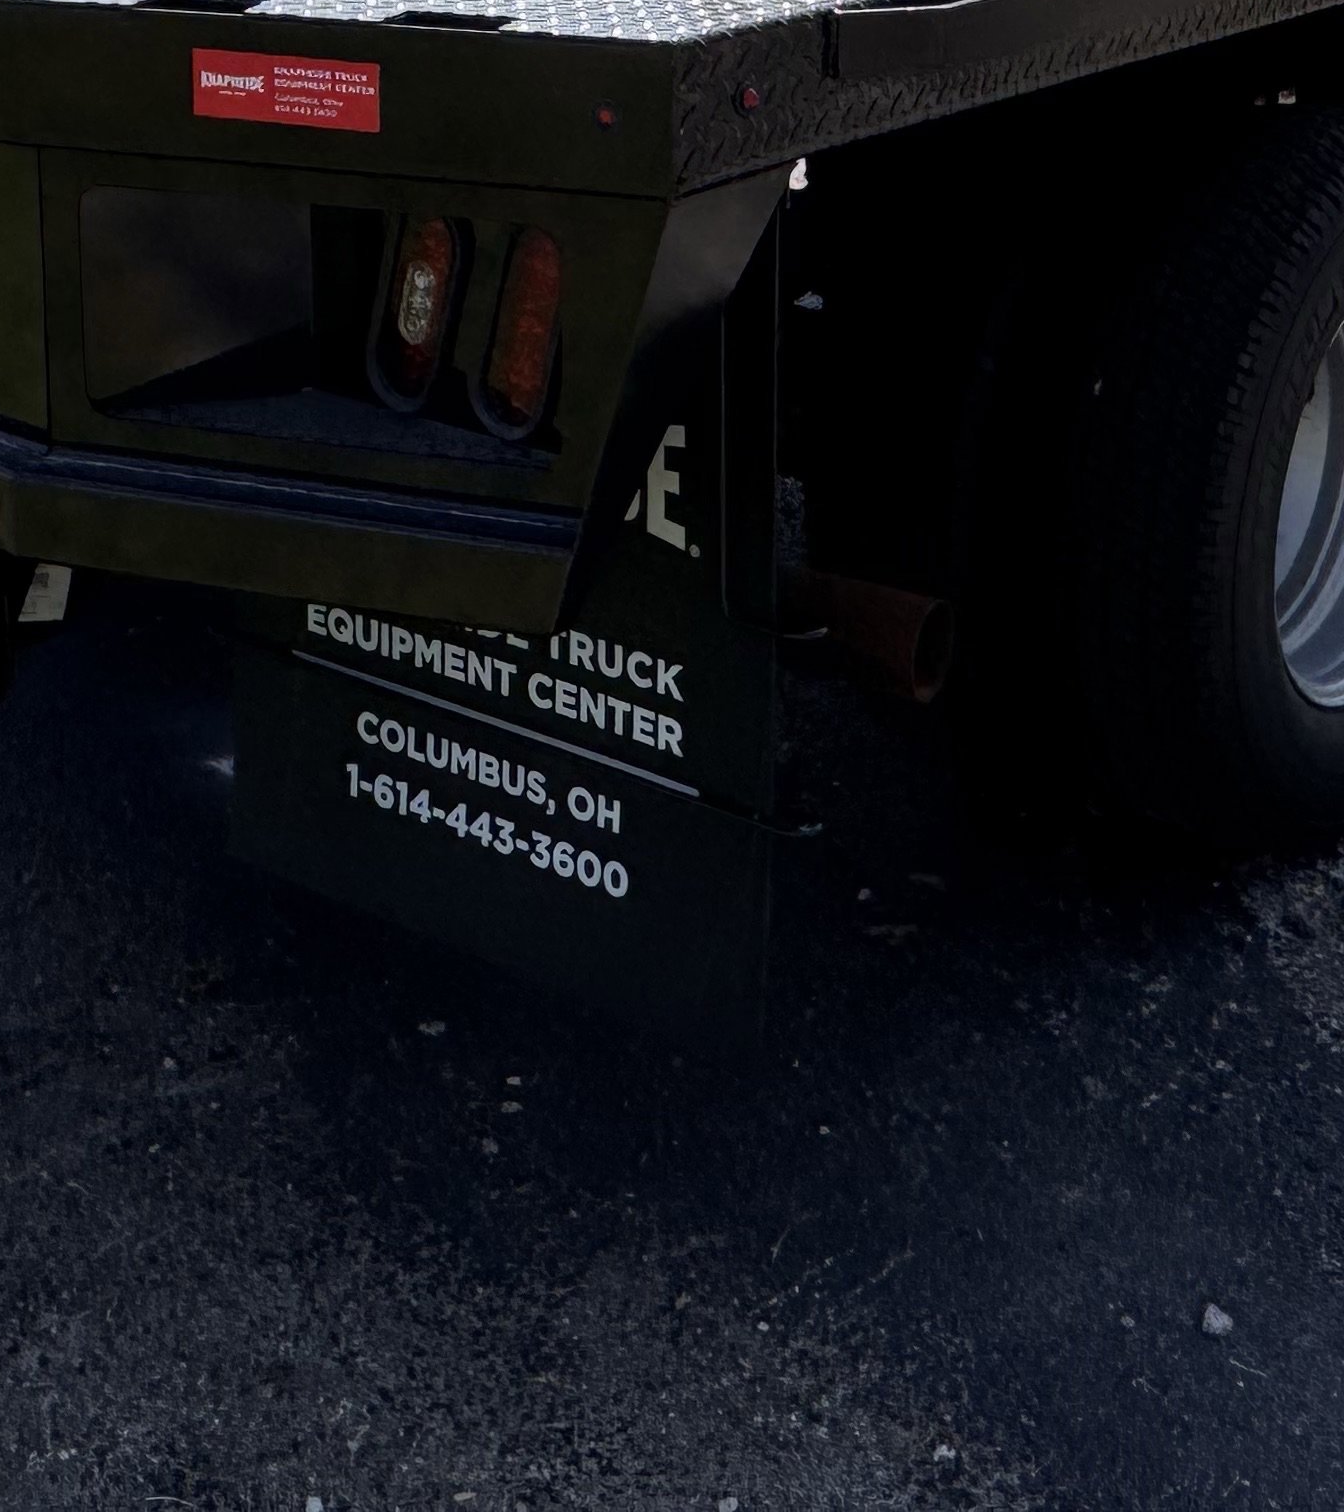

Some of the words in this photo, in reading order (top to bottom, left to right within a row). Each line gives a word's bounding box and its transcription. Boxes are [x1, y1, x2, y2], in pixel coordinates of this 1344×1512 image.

[307, 603, 517, 696] EQUIPMENT
[528, 673, 684, 757] CENTER
[550, 630, 684, 702] TRUCK
[346, 764, 629, 898] 1-614-443-3600
[357, 712, 555, 815] COLUMBUS,
[567, 787, 621, 833] OH
